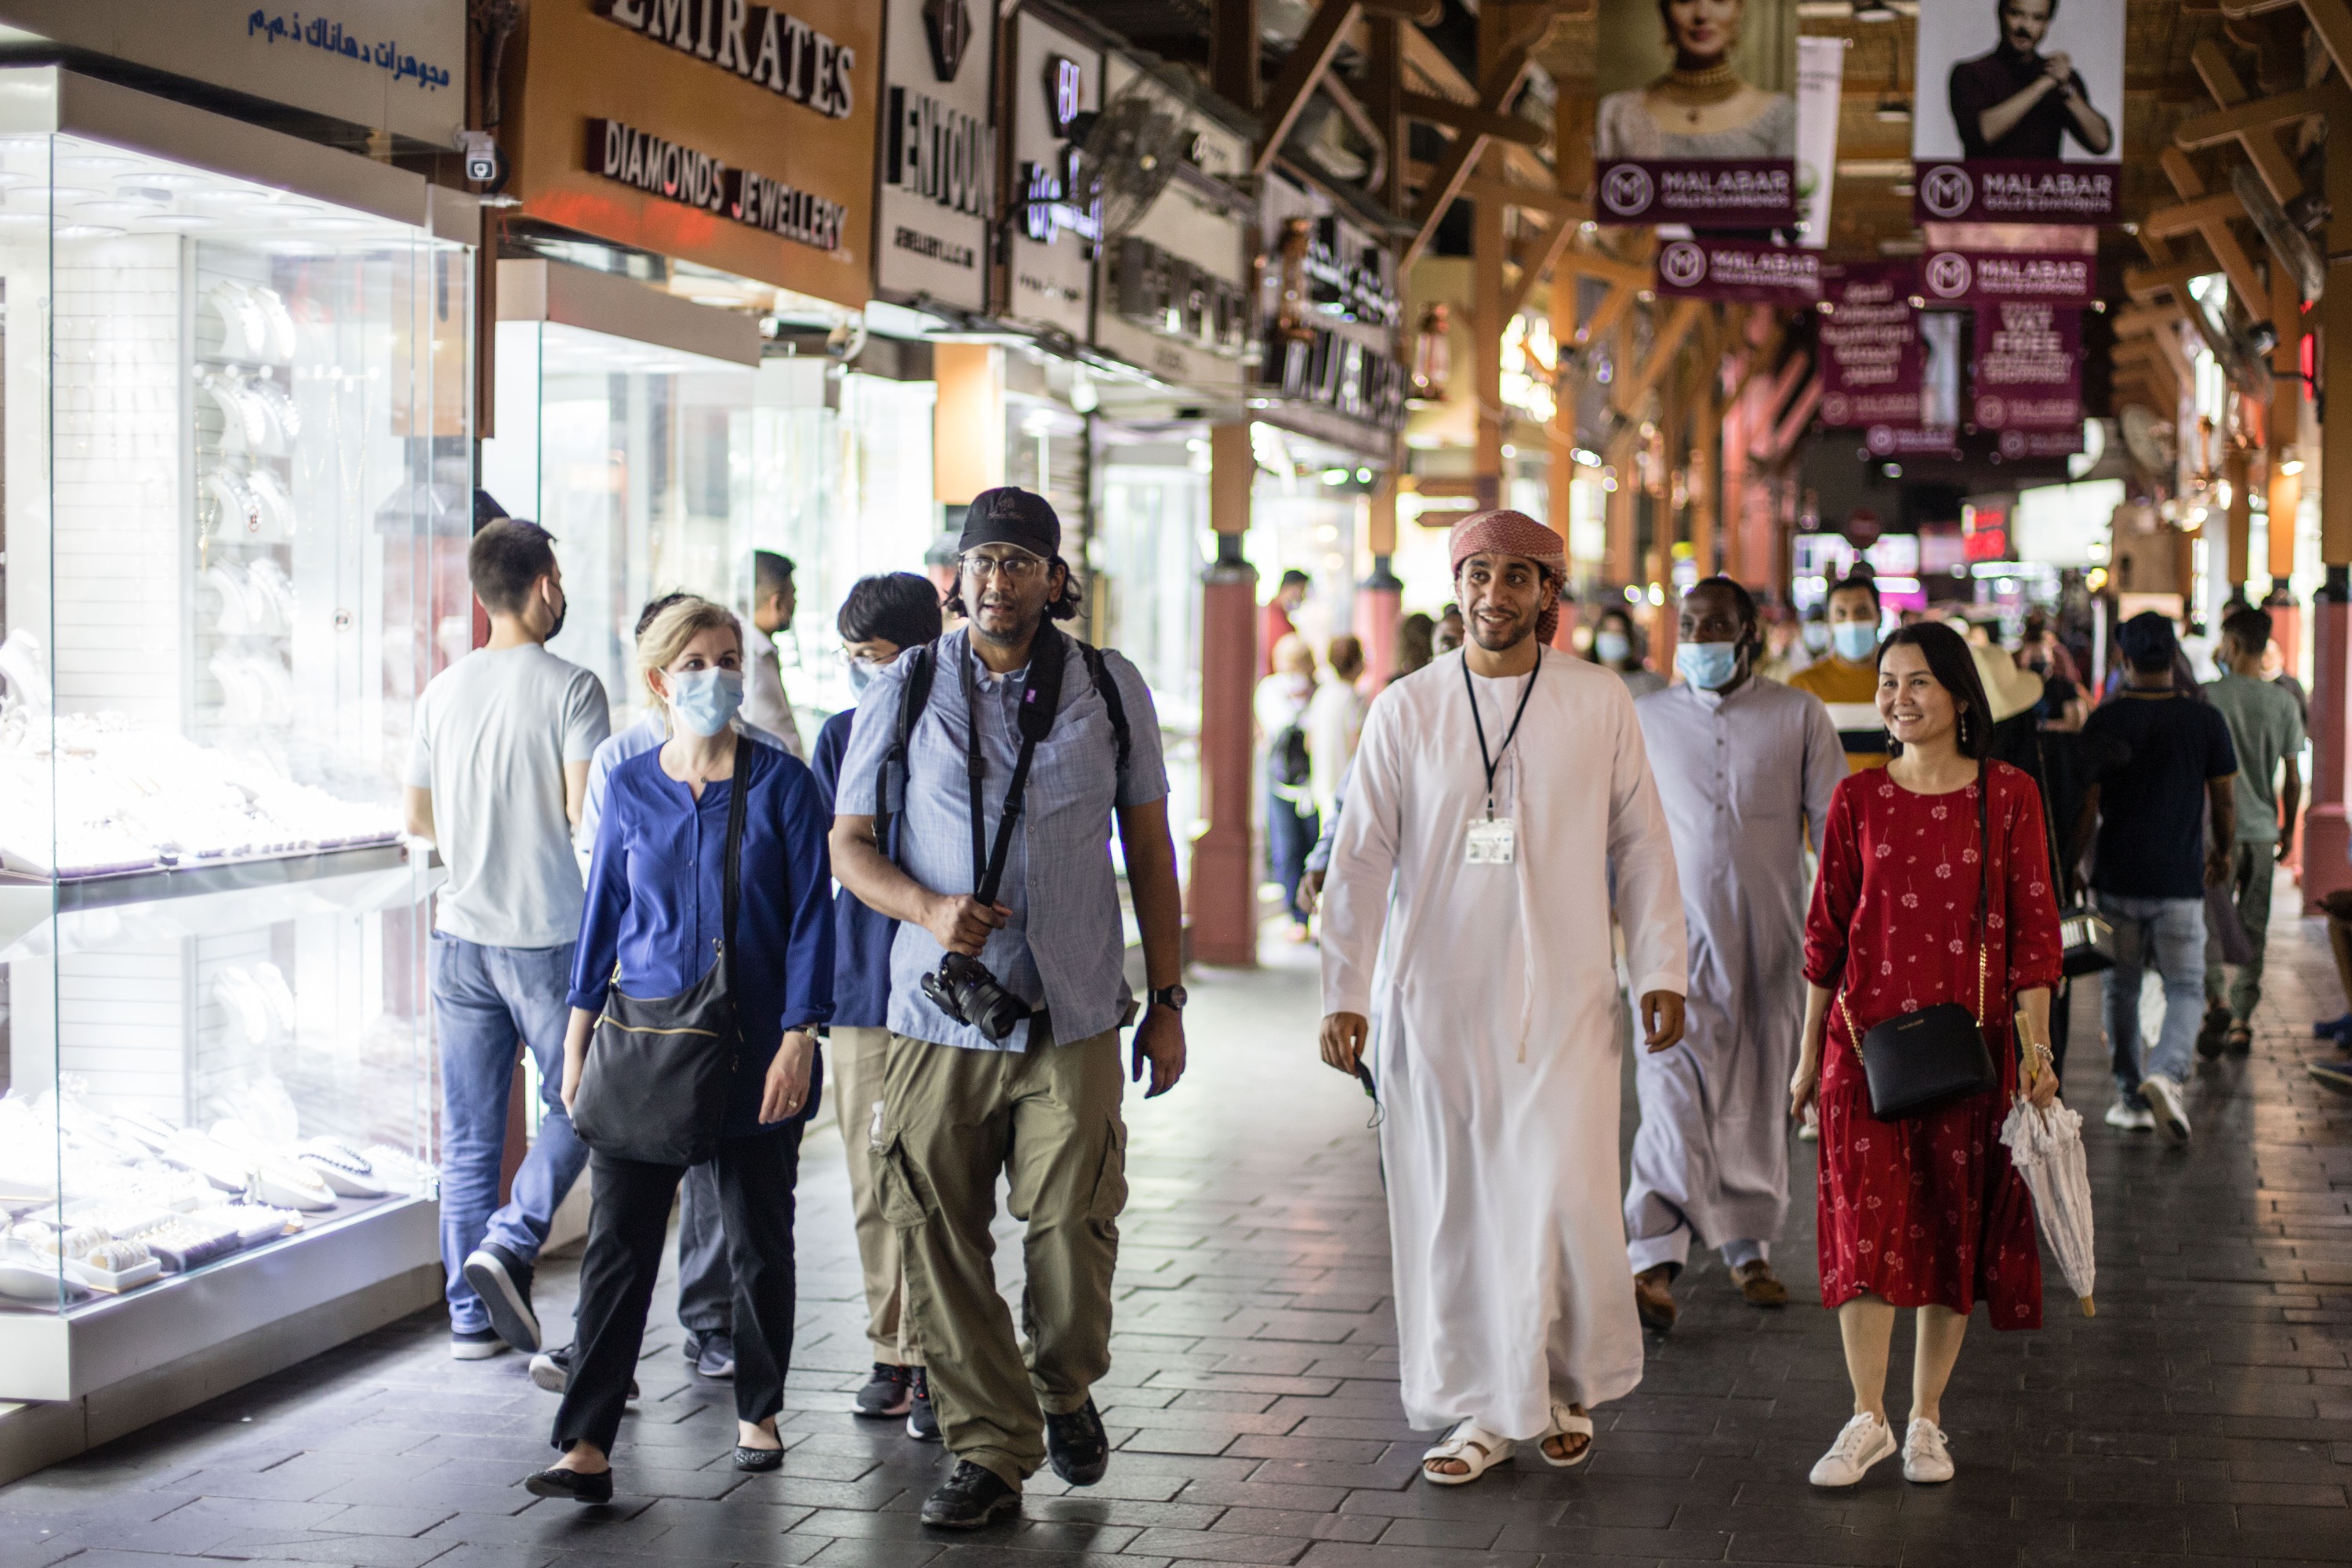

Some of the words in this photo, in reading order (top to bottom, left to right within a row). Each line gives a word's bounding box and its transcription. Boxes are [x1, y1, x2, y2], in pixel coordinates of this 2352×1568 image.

[375, 40, 449, 91] مجوهرات
[612, 0, 855, 119] MIRATES
[604, 118, 725, 212] DIAMONDS
[731, 169, 849, 251] JEWELLERY
[1661, 170, 1790, 193] MALABAR
[1982, 173, 2112, 198] MALABAR
[1710, 250, 1820, 273] MALABAR
[1976, 260, 2087, 279] MALABAR
